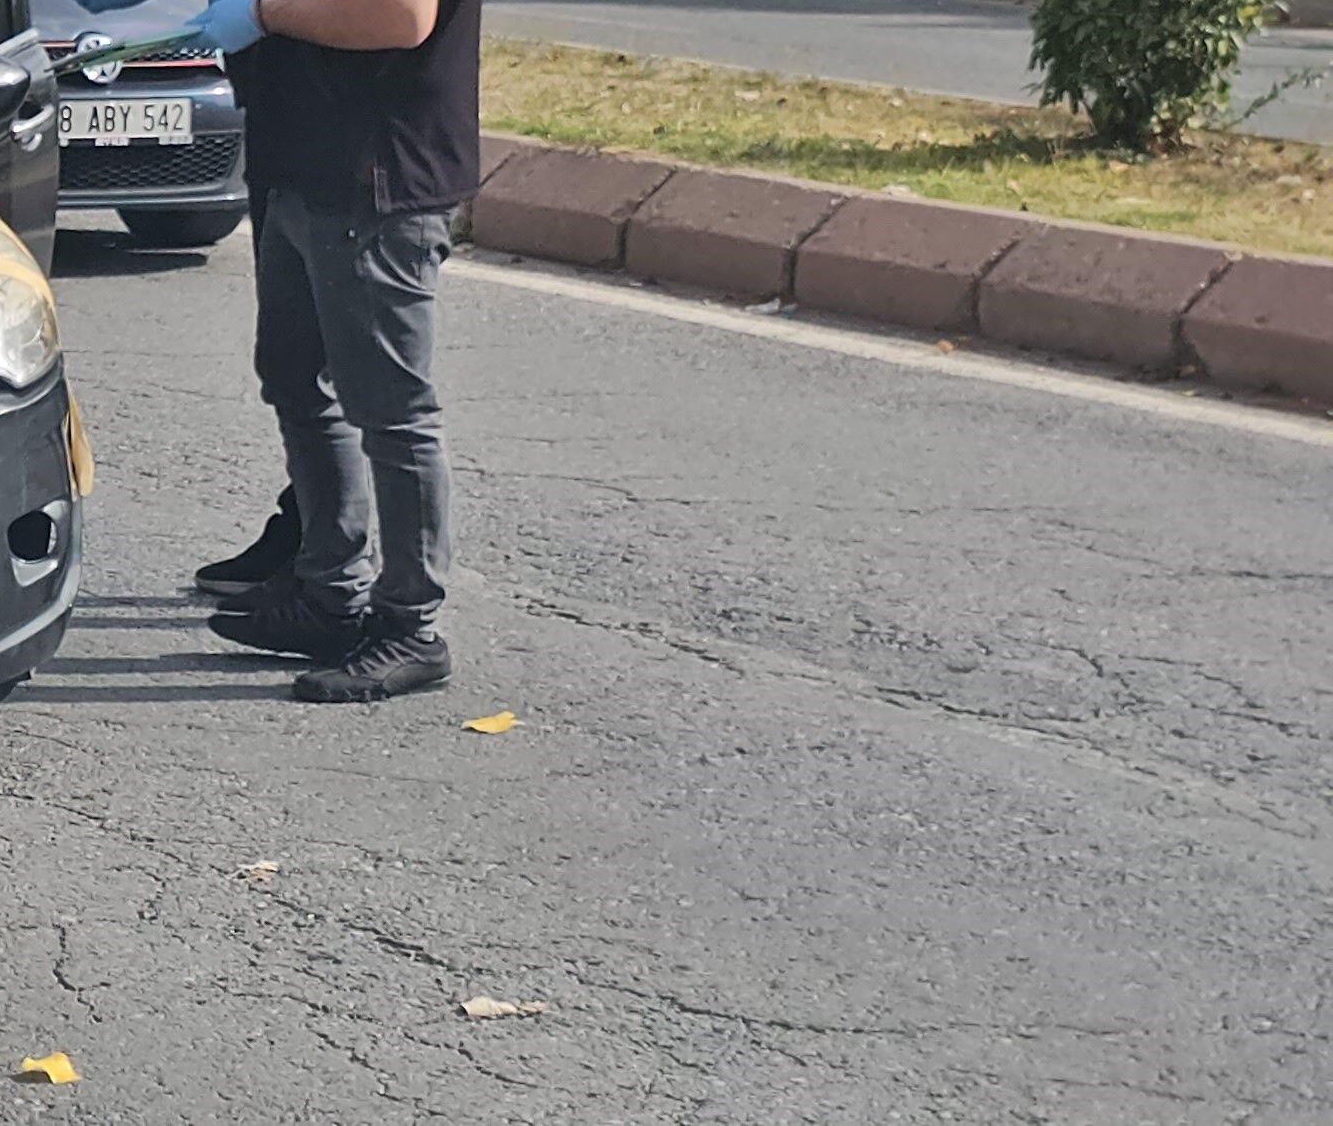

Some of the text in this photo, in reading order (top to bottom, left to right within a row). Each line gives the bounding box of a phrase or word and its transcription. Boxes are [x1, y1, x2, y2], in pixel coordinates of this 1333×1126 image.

[60, 103, 184, 133] 8 ABY 542
